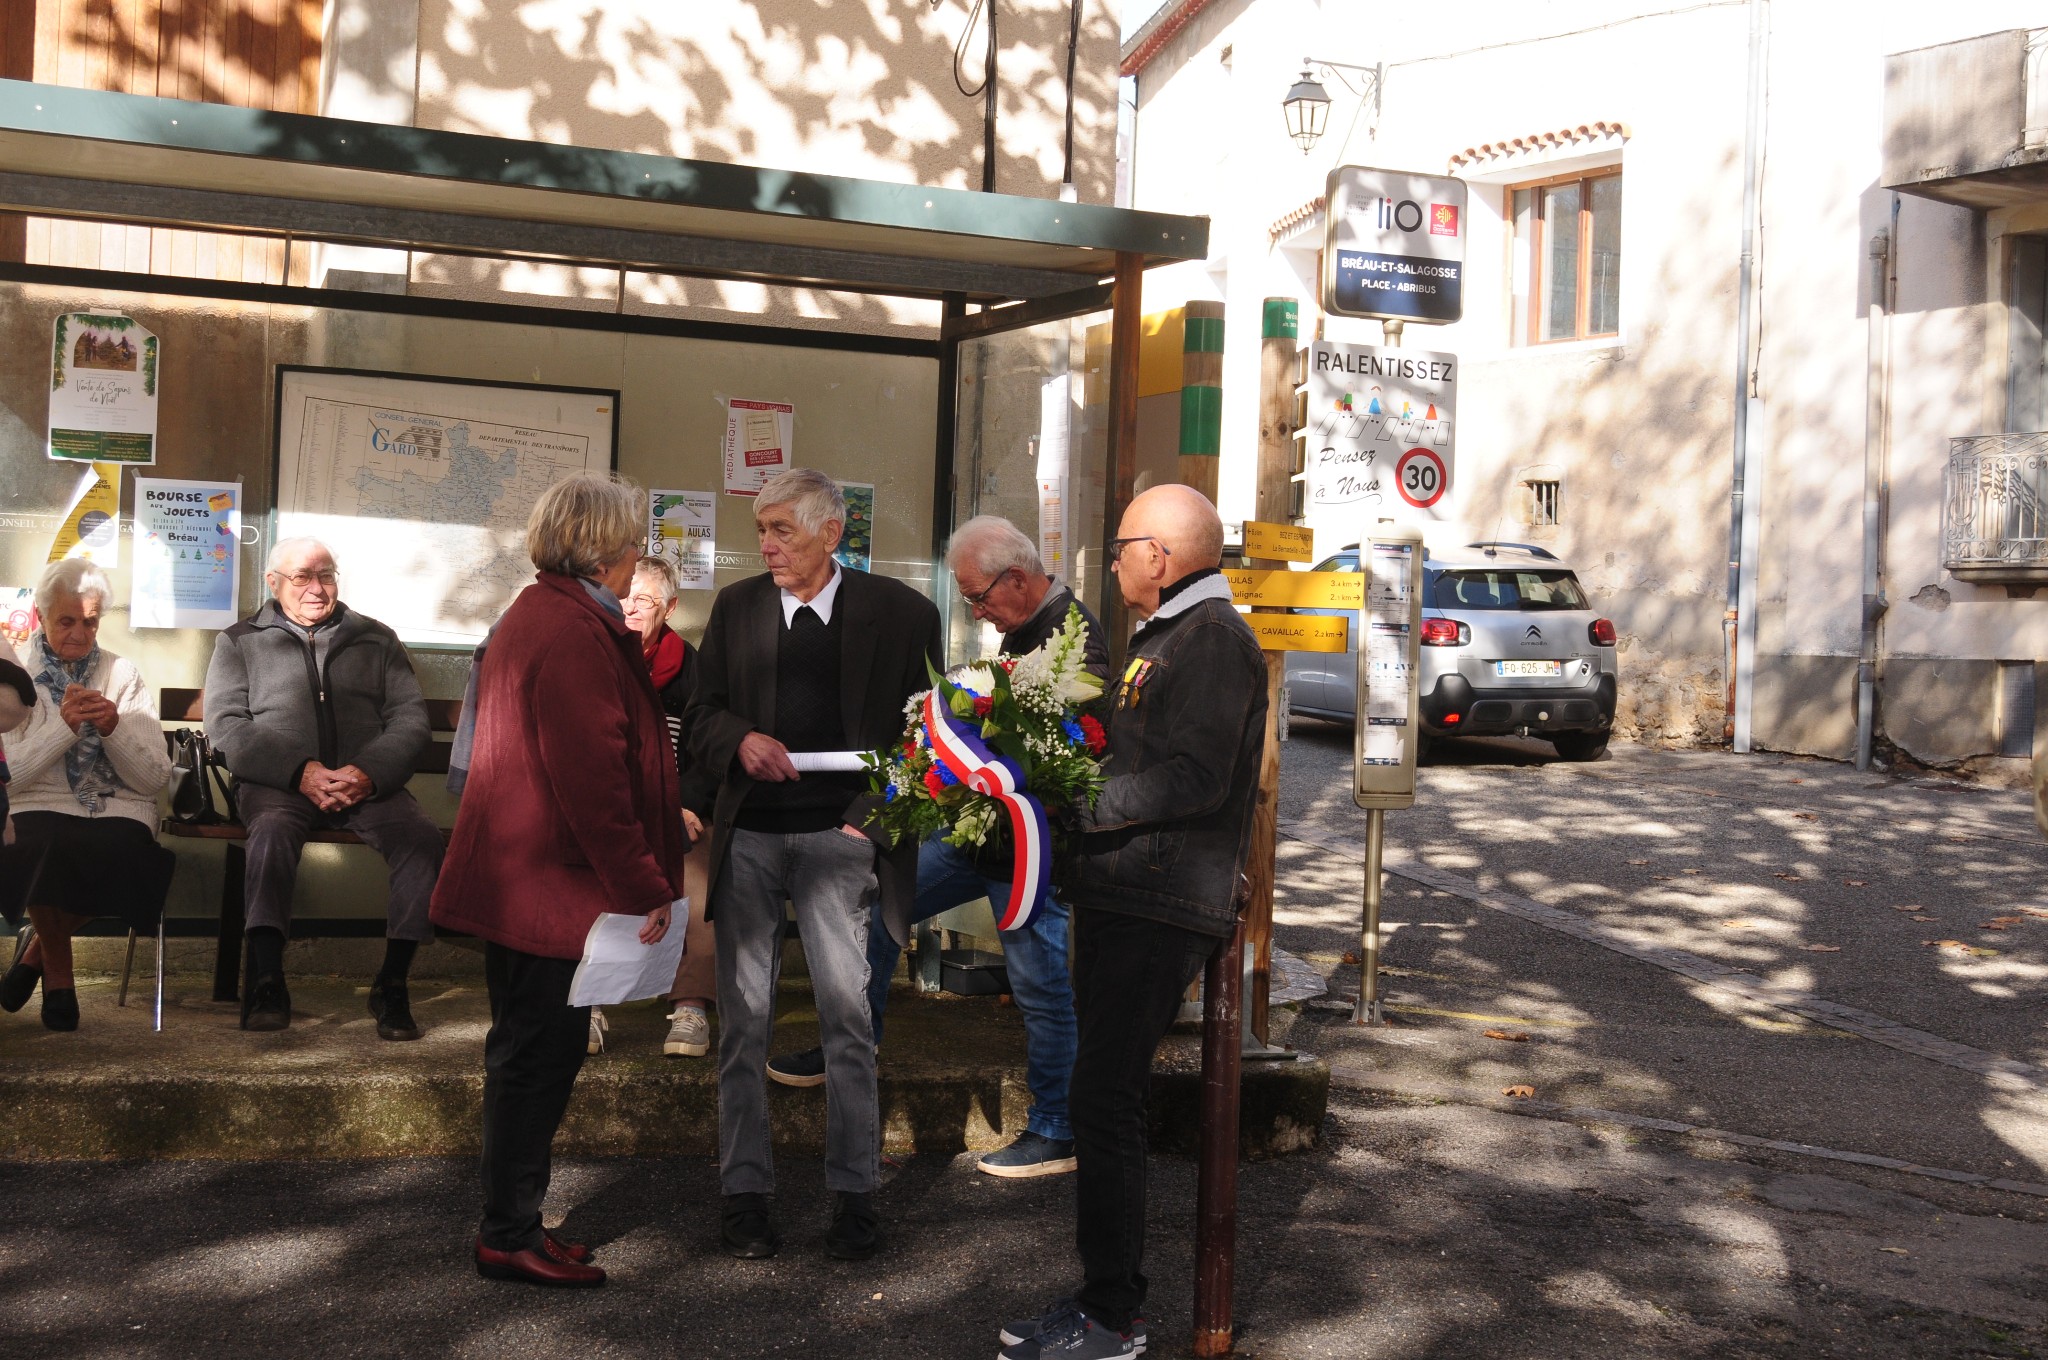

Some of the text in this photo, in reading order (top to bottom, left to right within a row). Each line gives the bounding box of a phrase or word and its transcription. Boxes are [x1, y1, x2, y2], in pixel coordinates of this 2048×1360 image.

[1341, 257, 1458, 279] BRÉAU-ET-SALAGOSSE
[1361, 278, 1391, 290] PLACE
[1397, 282, 1437, 294] ABRIBUS
[1317, 351, 1453, 382] RALENTISSEZ
[76, 380, 94, 392] Vente
[96, 380, 105, 392] de
[89, 393, 117, 405] de Noël
[375, 412, 406, 422] CONSEIL
[372, 428, 417, 456] GARD
[478, 435, 528, 446] DEPARTEMENTAL
[544, 443, 580, 454] TRANSPORTS
[1319, 447, 1377, 468] Pensez
[1405, 464, 1437, 492] 30
[1315, 476, 1381, 498] à Nous
[146, 490, 203, 503] BOURSE
[163, 508, 210, 518] JOUETS
[168, 532, 198, 542] Bréau
[688, 528, 711, 538] AULAS
[715, 555, 755, 566] CONSEIL
[1262, 627, 1305, 637] CAVAILLAC
[1314, 630, 1325, 638] 2.2
[1325, 630, 1335, 638] km
